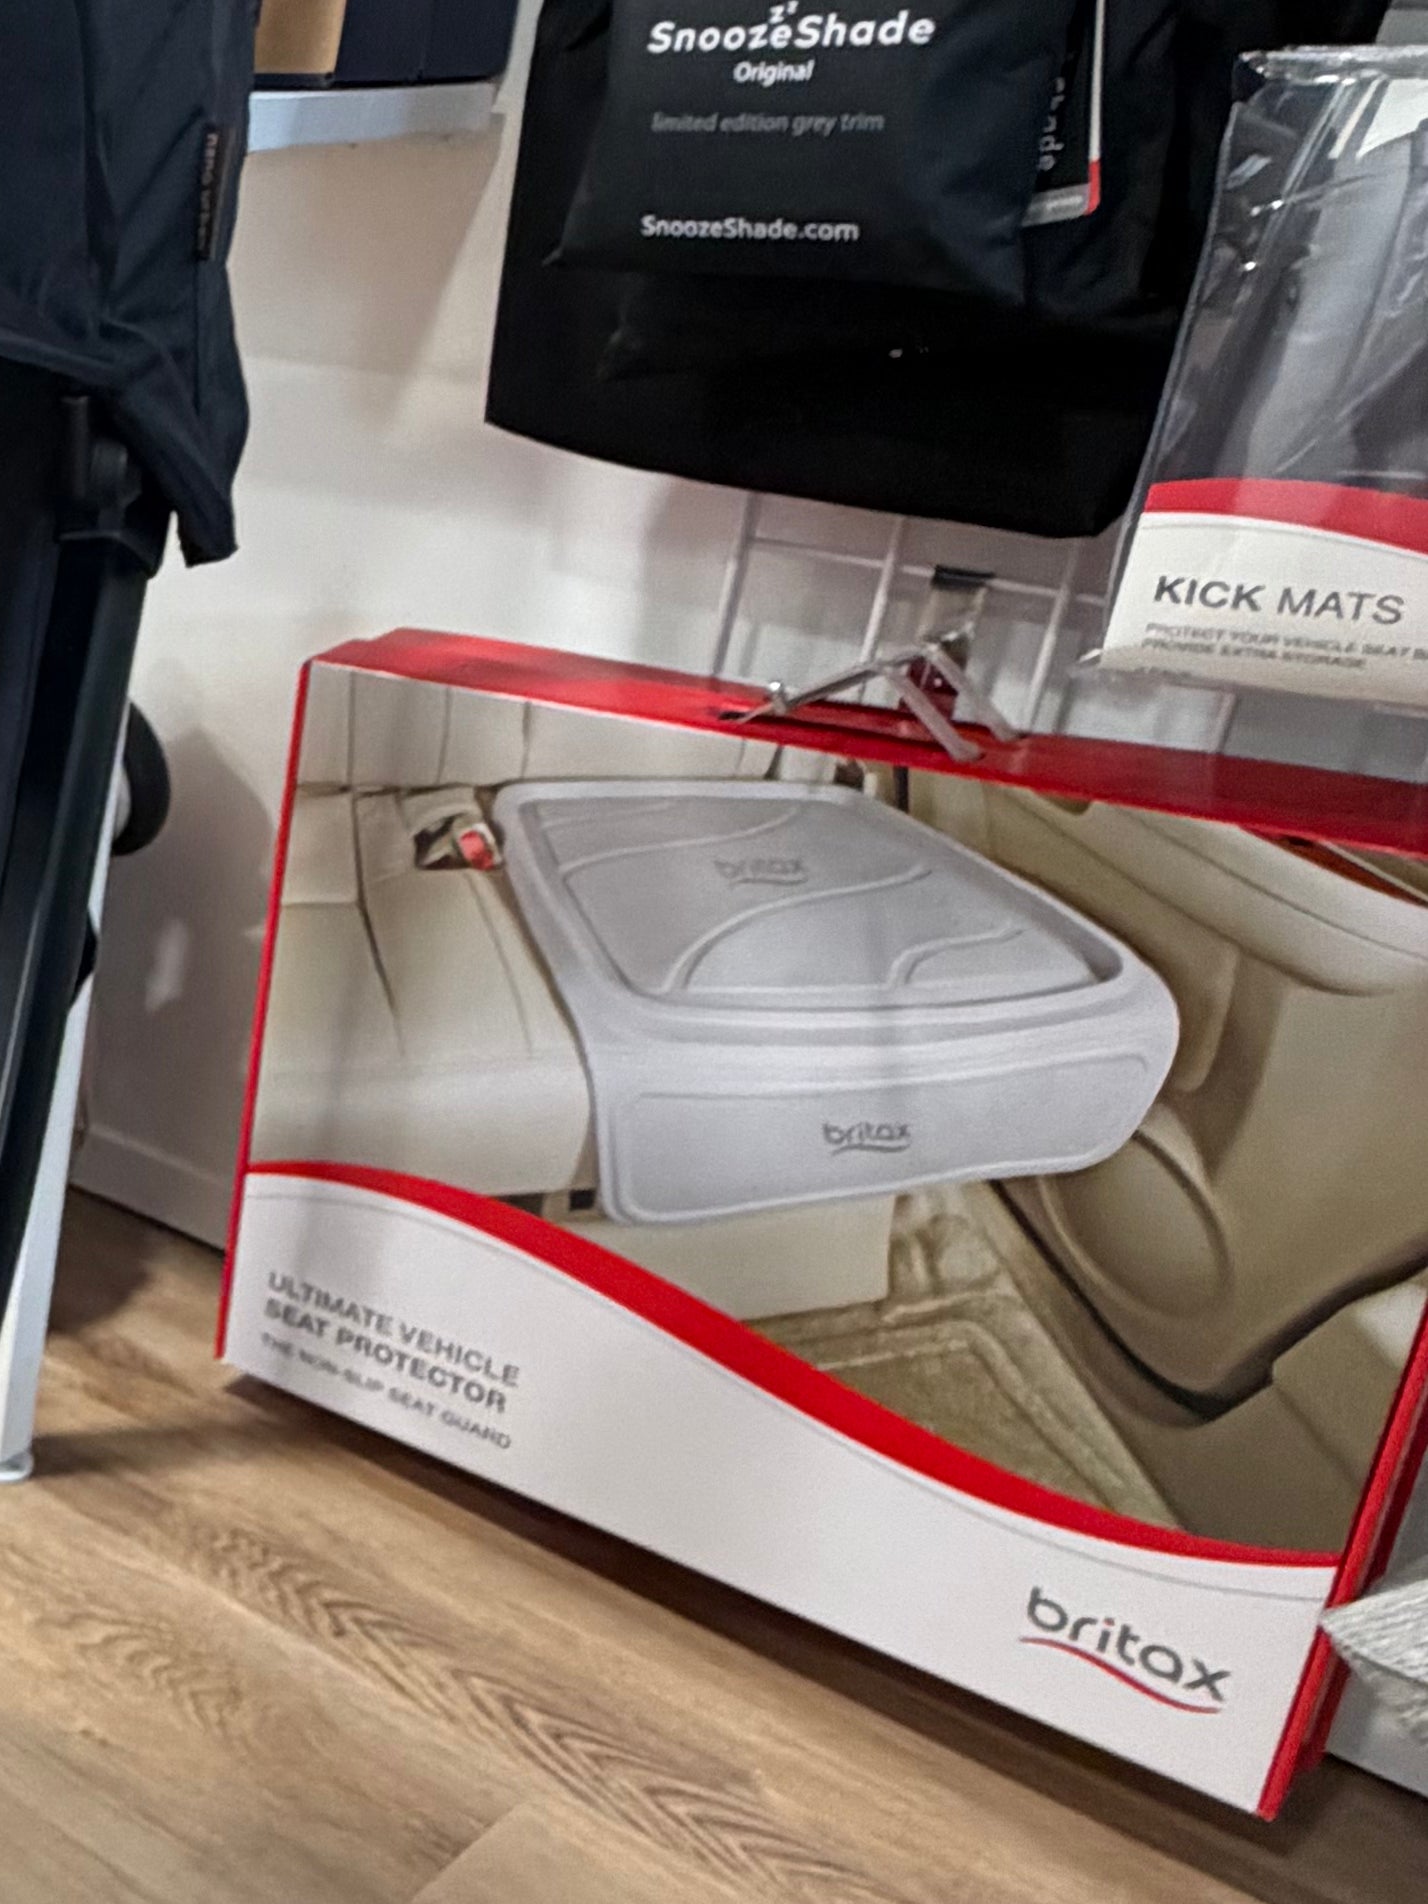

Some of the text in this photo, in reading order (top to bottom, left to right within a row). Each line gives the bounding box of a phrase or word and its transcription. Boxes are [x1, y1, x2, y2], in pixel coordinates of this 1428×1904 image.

[647, 9, 935, 53] SnoozeShade
[733, 60, 815, 87] Original
[652, 112, 884, 137] limited edition grey trim
[641, 214, 860, 242] SnoozeShade.com
[1153, 576, 1404, 625] KICK MATS
[822, 1122, 910, 1145] britax
[267, 1271, 520, 1388] ULTIMATE VEHICLE
[264, 1298, 506, 1413] SEAT PROTECTOR
[388, 1387, 436, 1417] SEAT
[440, 1410, 511, 1449] GUARD
[1027, 1585, 1231, 1702] britax
